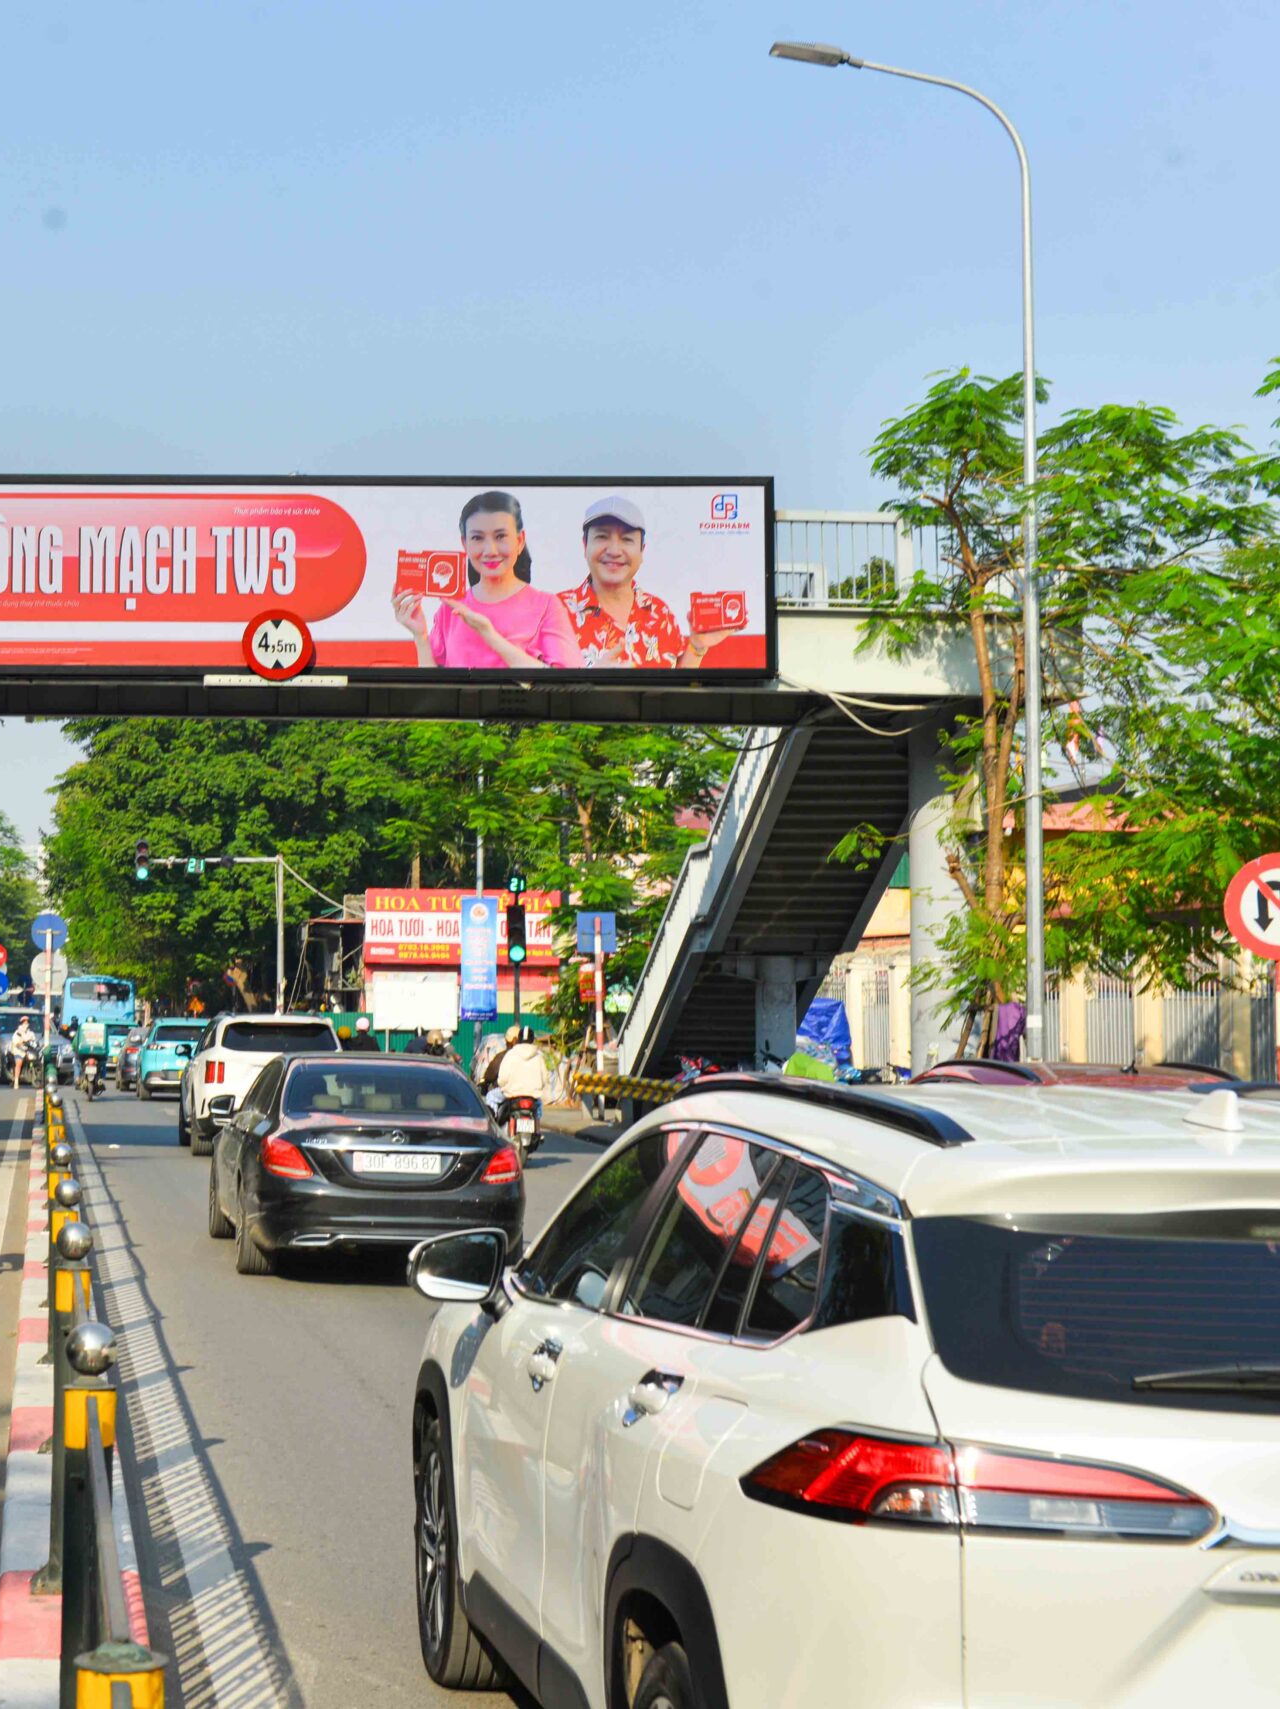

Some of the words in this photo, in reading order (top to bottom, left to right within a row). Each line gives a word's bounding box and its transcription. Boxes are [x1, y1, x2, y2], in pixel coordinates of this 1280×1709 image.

[78, 525, 197, 611] MẠCH
[210, 526, 297, 595] TW3
[257, 632, 297, 655] 4,5m
[375, 896, 420, 911] HOA
[370, 919, 394, 936] HOA
[399, 917, 424, 936] TƯƠI
[437, 919, 460, 937] HOA
